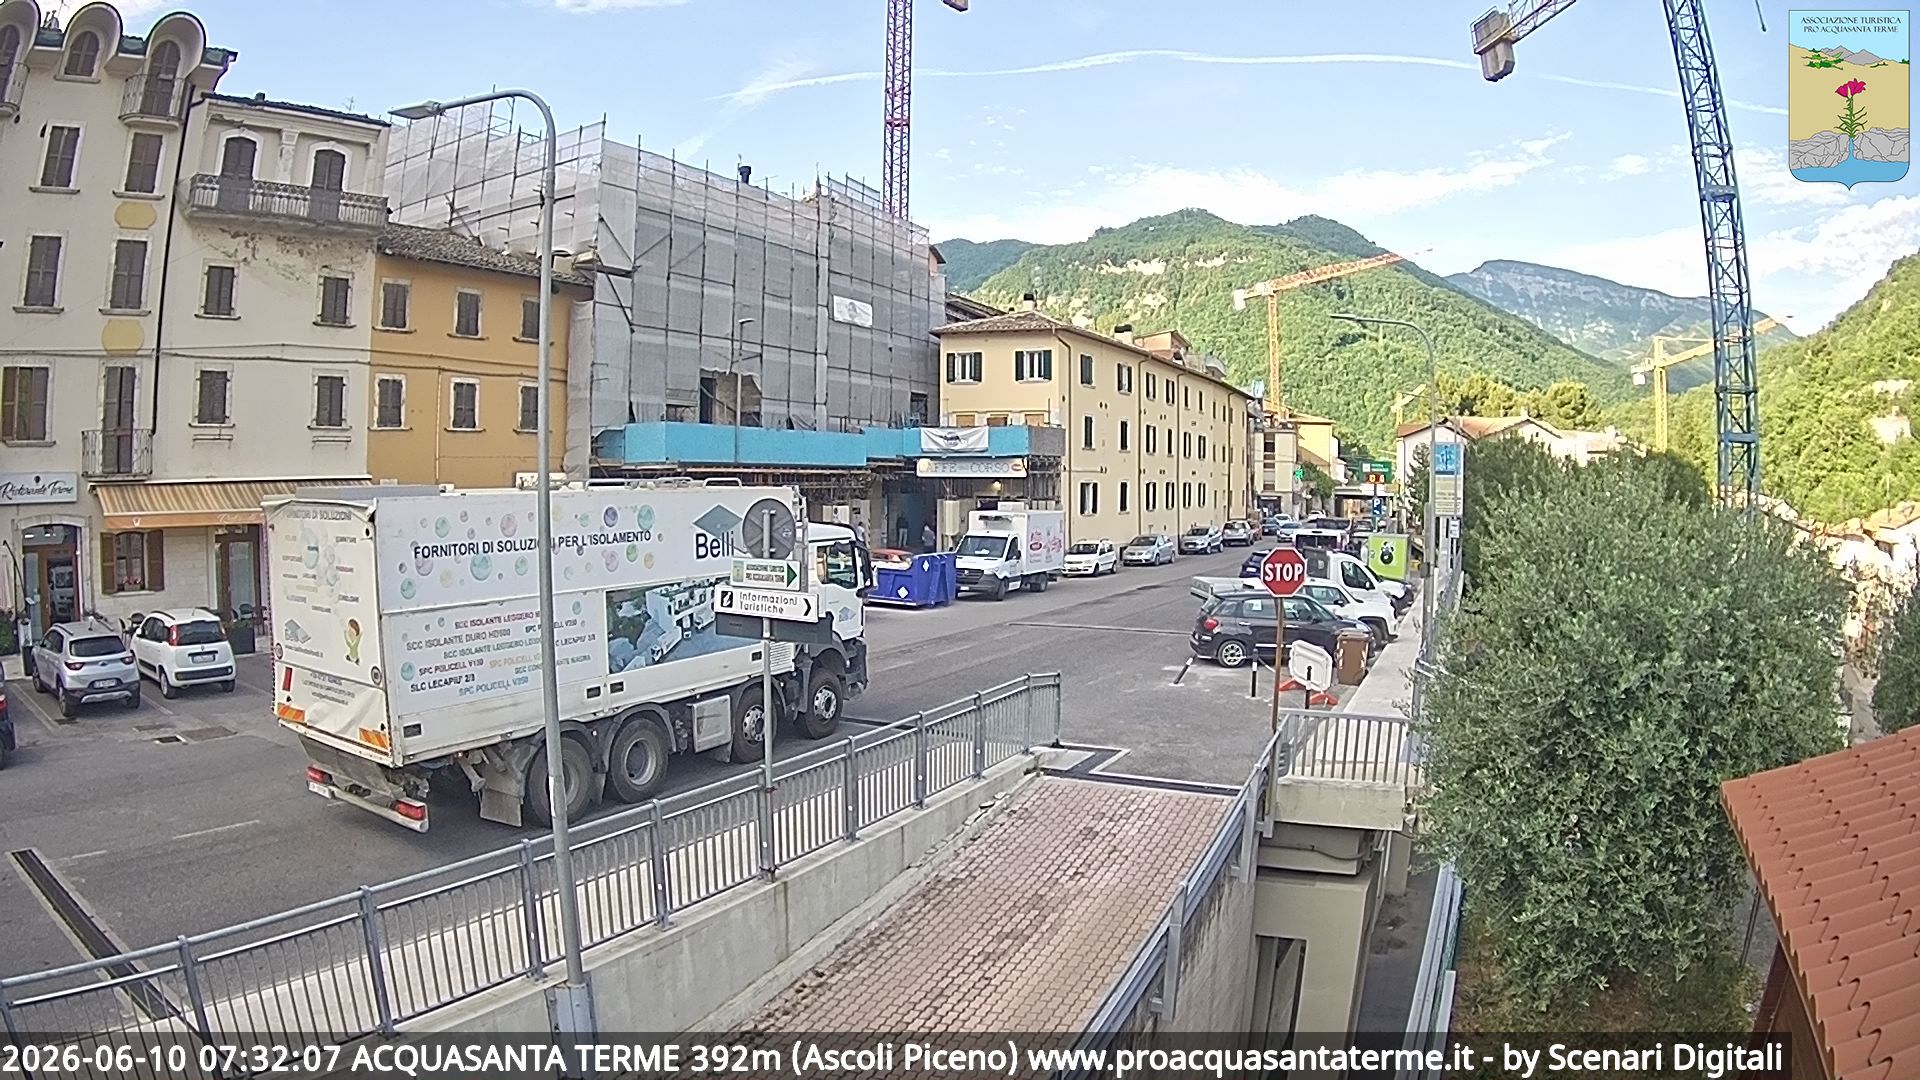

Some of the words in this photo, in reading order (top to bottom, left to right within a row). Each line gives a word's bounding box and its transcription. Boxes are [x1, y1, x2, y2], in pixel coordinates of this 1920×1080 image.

[970, 462, 1010, 473] CORSO
[414, 540, 479, 559] FORNITORI
[482, 540, 494, 554] DI
[558, 535, 579, 548] PER
[581, 530, 652, 547] L'ISOLAMENTO
[695, 530, 735, 560] Belli
[1264, 563, 1304, 582] STOP
[739, 591, 798, 606] Informazioni
[739, 600, 785, 614] Turistiche
[470, 615, 502, 628] ISOLANTE
[425, 634, 463, 648] ISOLANTE
[465, 630, 486, 642] DURO
[459, 644, 491, 657] ISOLANTE
[418, 666, 433, 676] SPC
[434, 661, 467, 674] POLICELL
[410, 681, 426, 693] SLC
[458, 686, 475, 697] SPC
[476, 680, 511, 693] POLICELL
